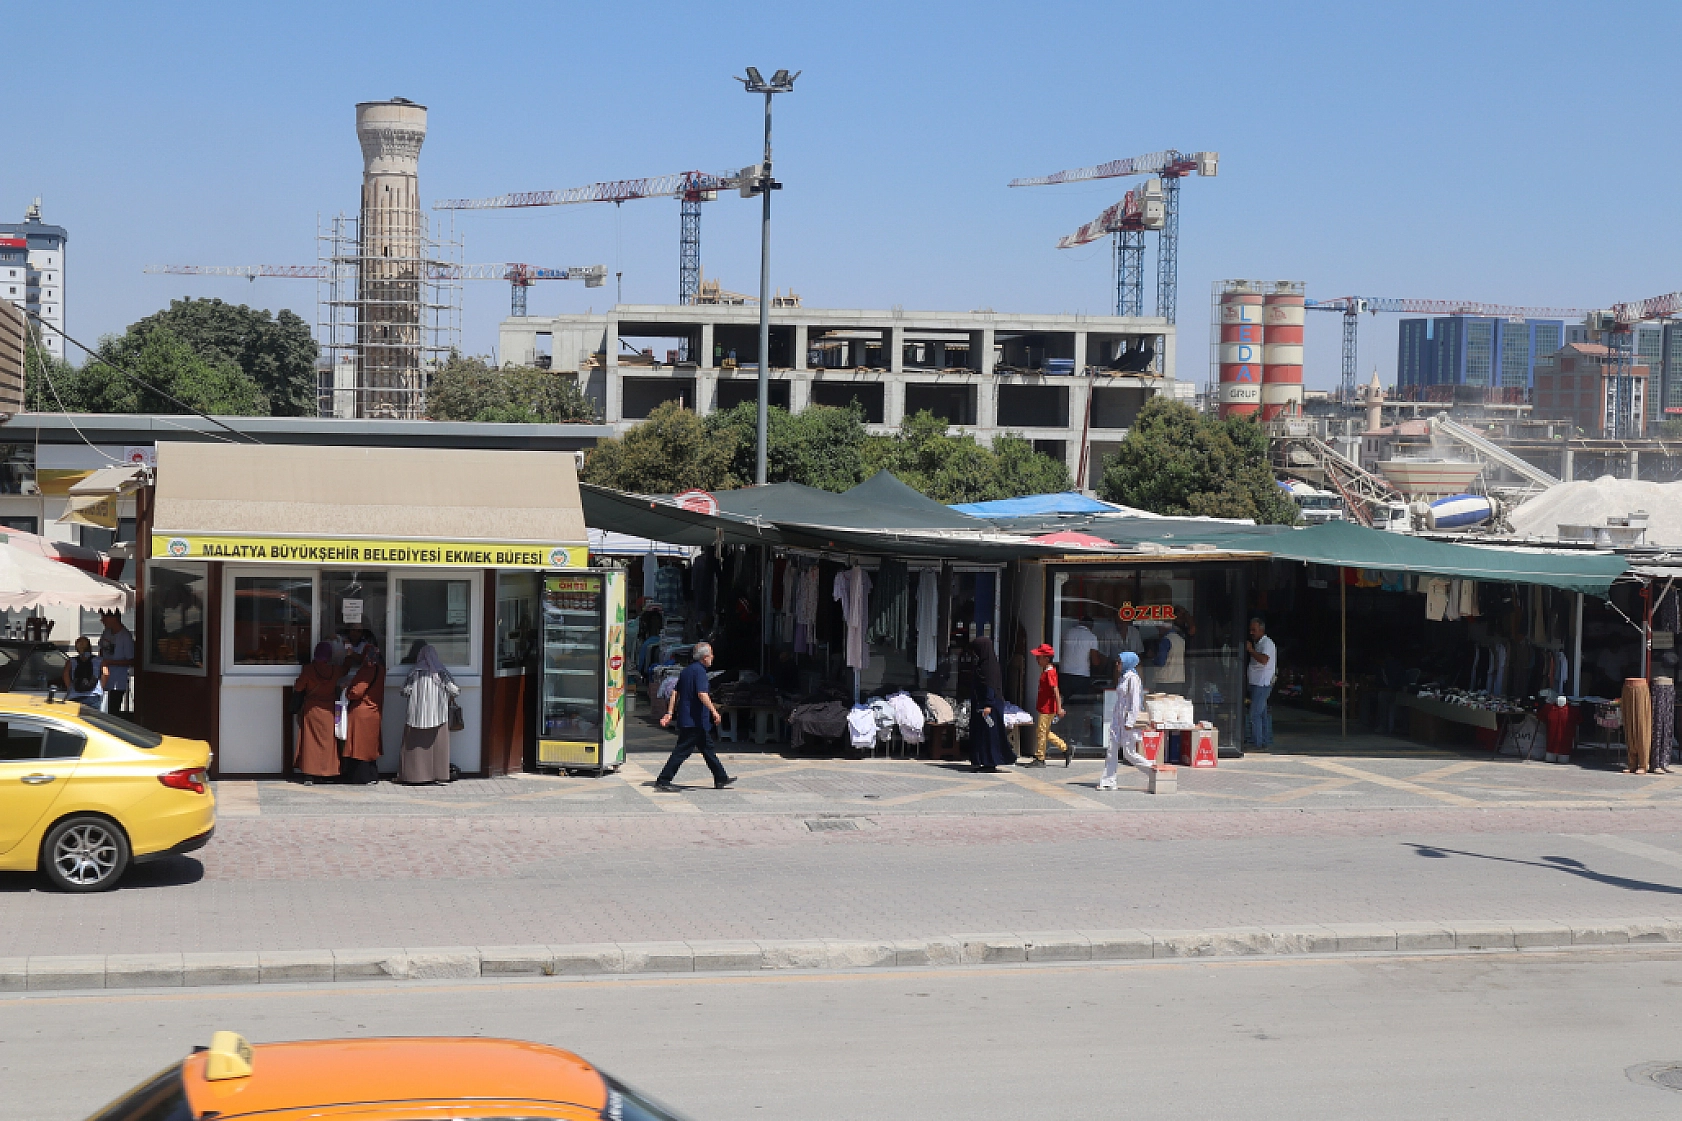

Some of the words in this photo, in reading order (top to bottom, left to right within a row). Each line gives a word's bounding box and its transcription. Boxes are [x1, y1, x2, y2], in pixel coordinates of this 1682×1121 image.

[1230, 388, 1257, 398] GRUP
[203, 543, 266, 558] MALATYA
[271, 544, 359, 562] BÜYÜKŞEHİR
[363, 547, 441, 562] BELEDİYESİ
[445, 550, 492, 563] EKMEK
[496, 550, 543, 565] BÜFESİ
[1118, 601, 1177, 622] ÖZER
